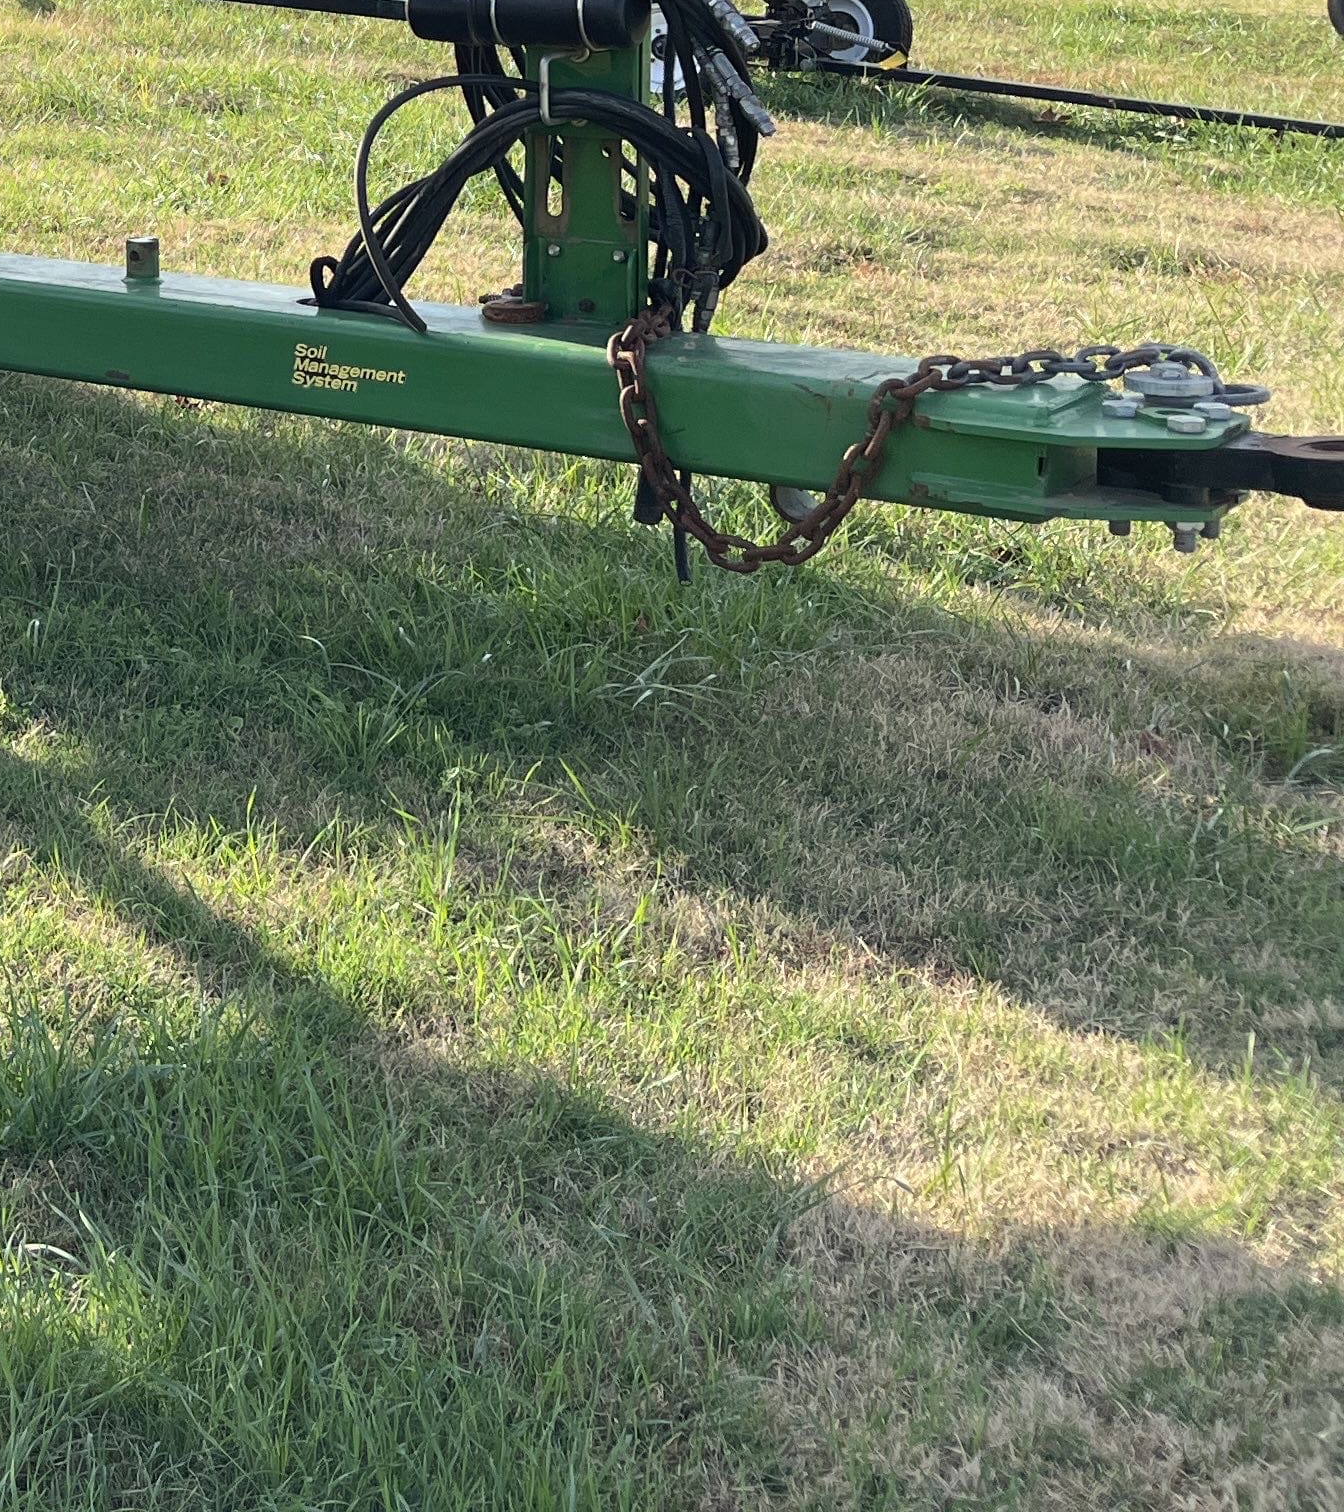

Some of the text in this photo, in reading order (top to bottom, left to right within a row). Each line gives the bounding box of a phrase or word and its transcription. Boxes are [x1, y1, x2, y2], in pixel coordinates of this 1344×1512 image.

[294, 343, 328, 360] Soil
[292, 371, 358, 393] System
[293, 357, 407, 385] Management
